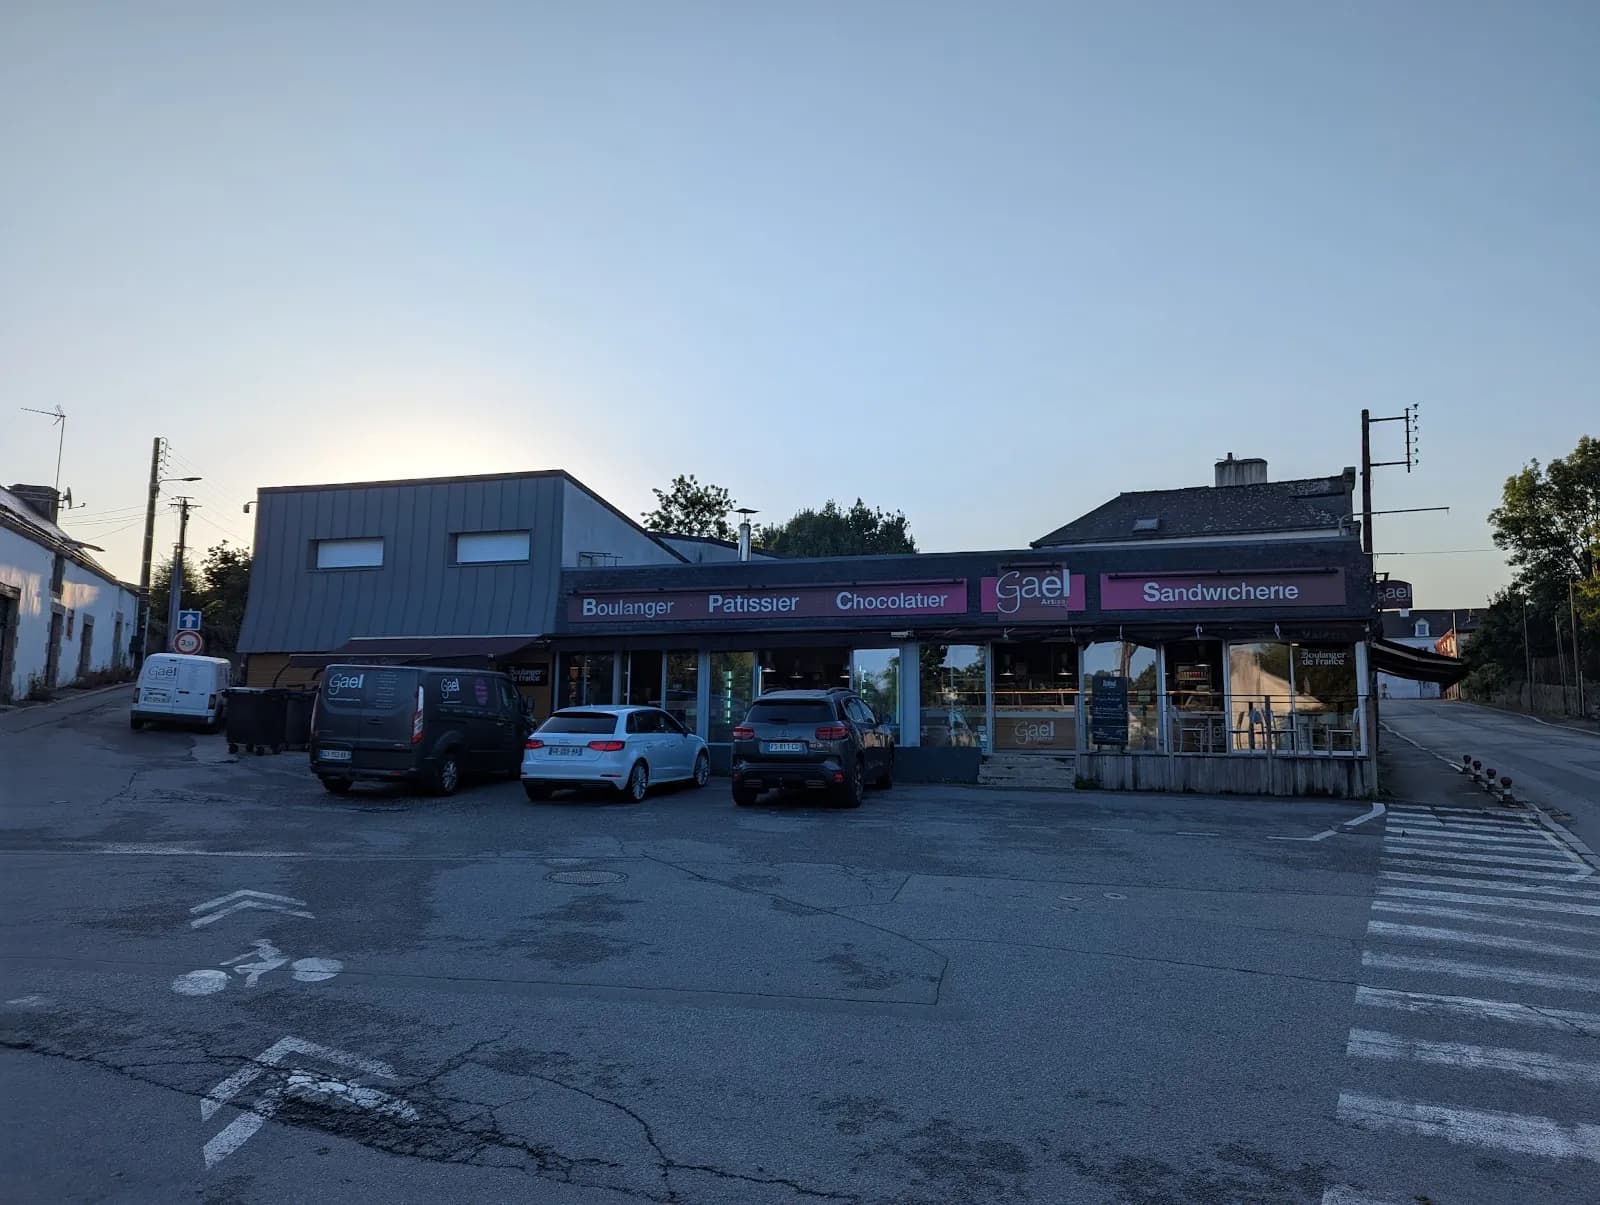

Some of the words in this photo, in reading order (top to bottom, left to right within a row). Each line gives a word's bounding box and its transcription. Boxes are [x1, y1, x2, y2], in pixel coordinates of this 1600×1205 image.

[995, 568, 1070, 614] Gaël
[1143, 581, 1299, 602] Sandwicherie
[582, 598, 675, 618] Boulanger
[708, 594, 800, 613] Patissier
[835, 591, 948, 610] Chocolatier
[1302, 656, 1314, 666] de
[1315, 658, 1345, 666] France
